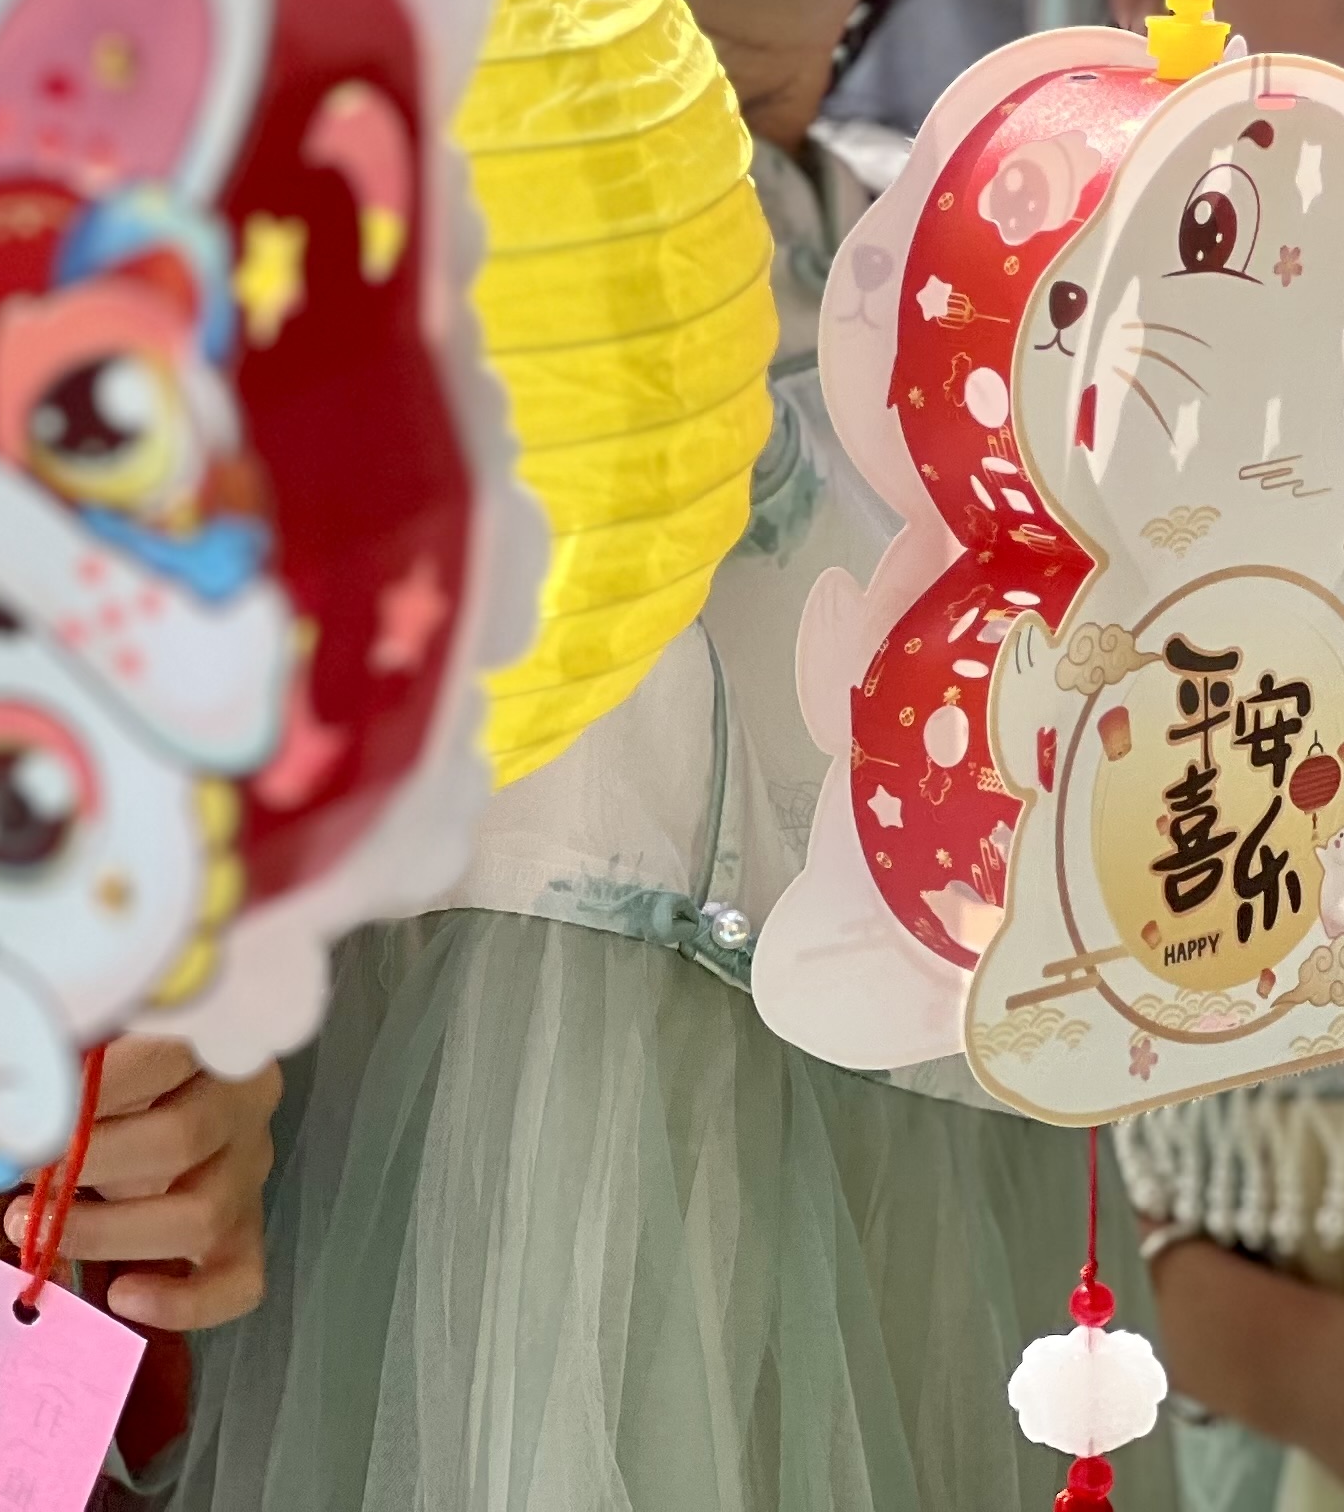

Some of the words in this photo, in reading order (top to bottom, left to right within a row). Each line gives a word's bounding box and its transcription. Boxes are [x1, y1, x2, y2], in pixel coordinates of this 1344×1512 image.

[1163, 635, 1312, 788] 平安
[1152, 764, 1303, 943] 喜乐
[1163, 932, 1221, 967] HAPPY
